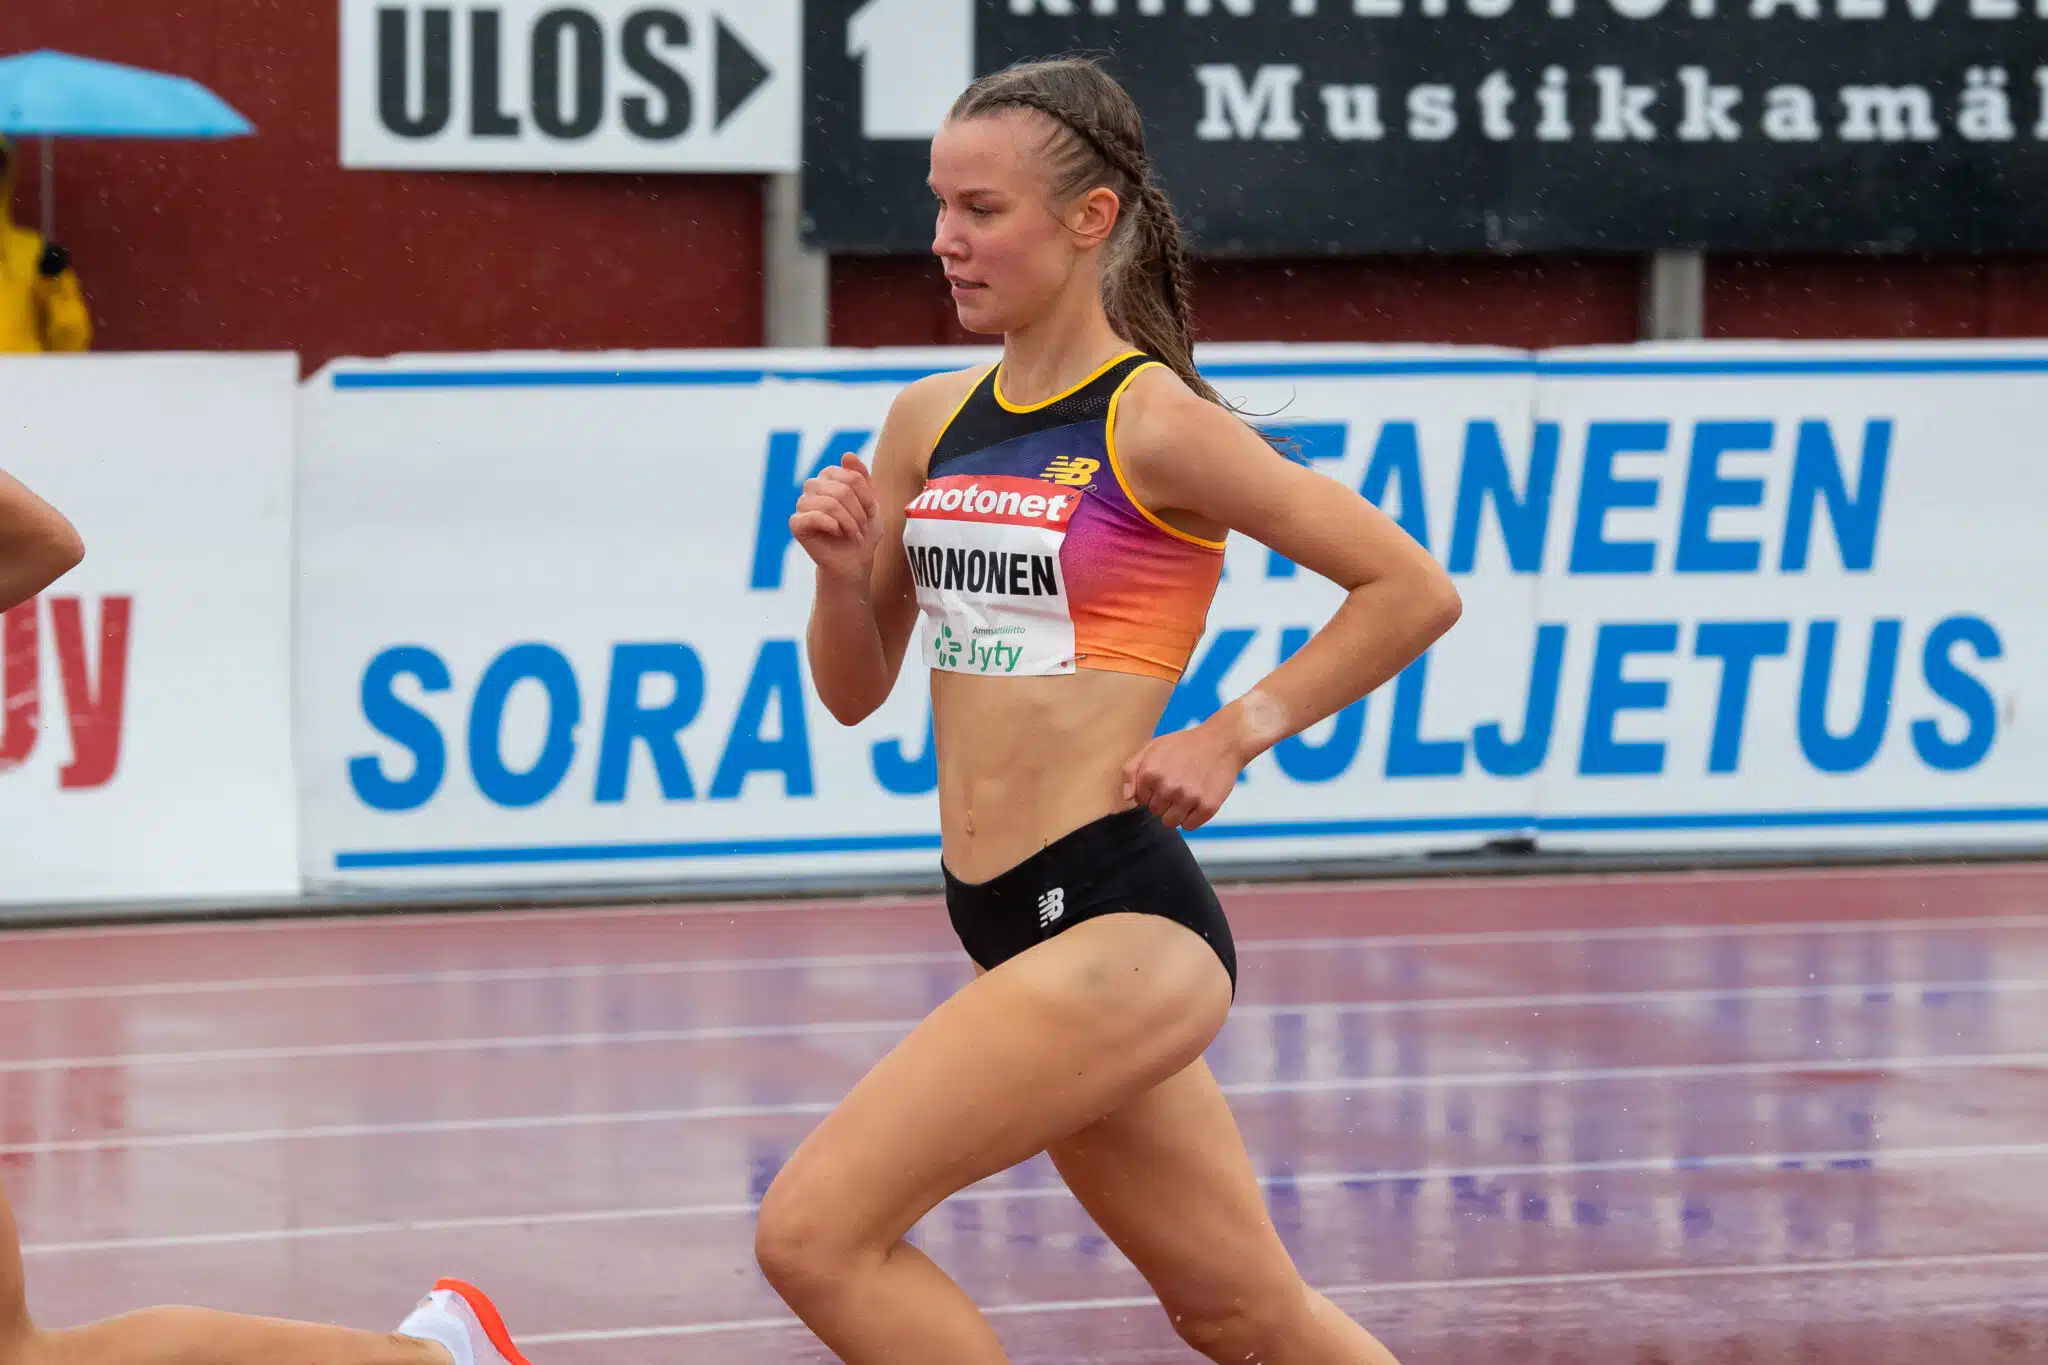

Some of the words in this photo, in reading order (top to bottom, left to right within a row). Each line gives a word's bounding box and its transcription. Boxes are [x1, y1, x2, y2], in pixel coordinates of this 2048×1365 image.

[378, 6, 692, 141] ULOS
[908, 483, 1068, 522] motonet
[907, 545, 1058, 596] MONONEN
[967, 638, 1024, 673] Jyty
[348, 639, 816, 812] SORA
